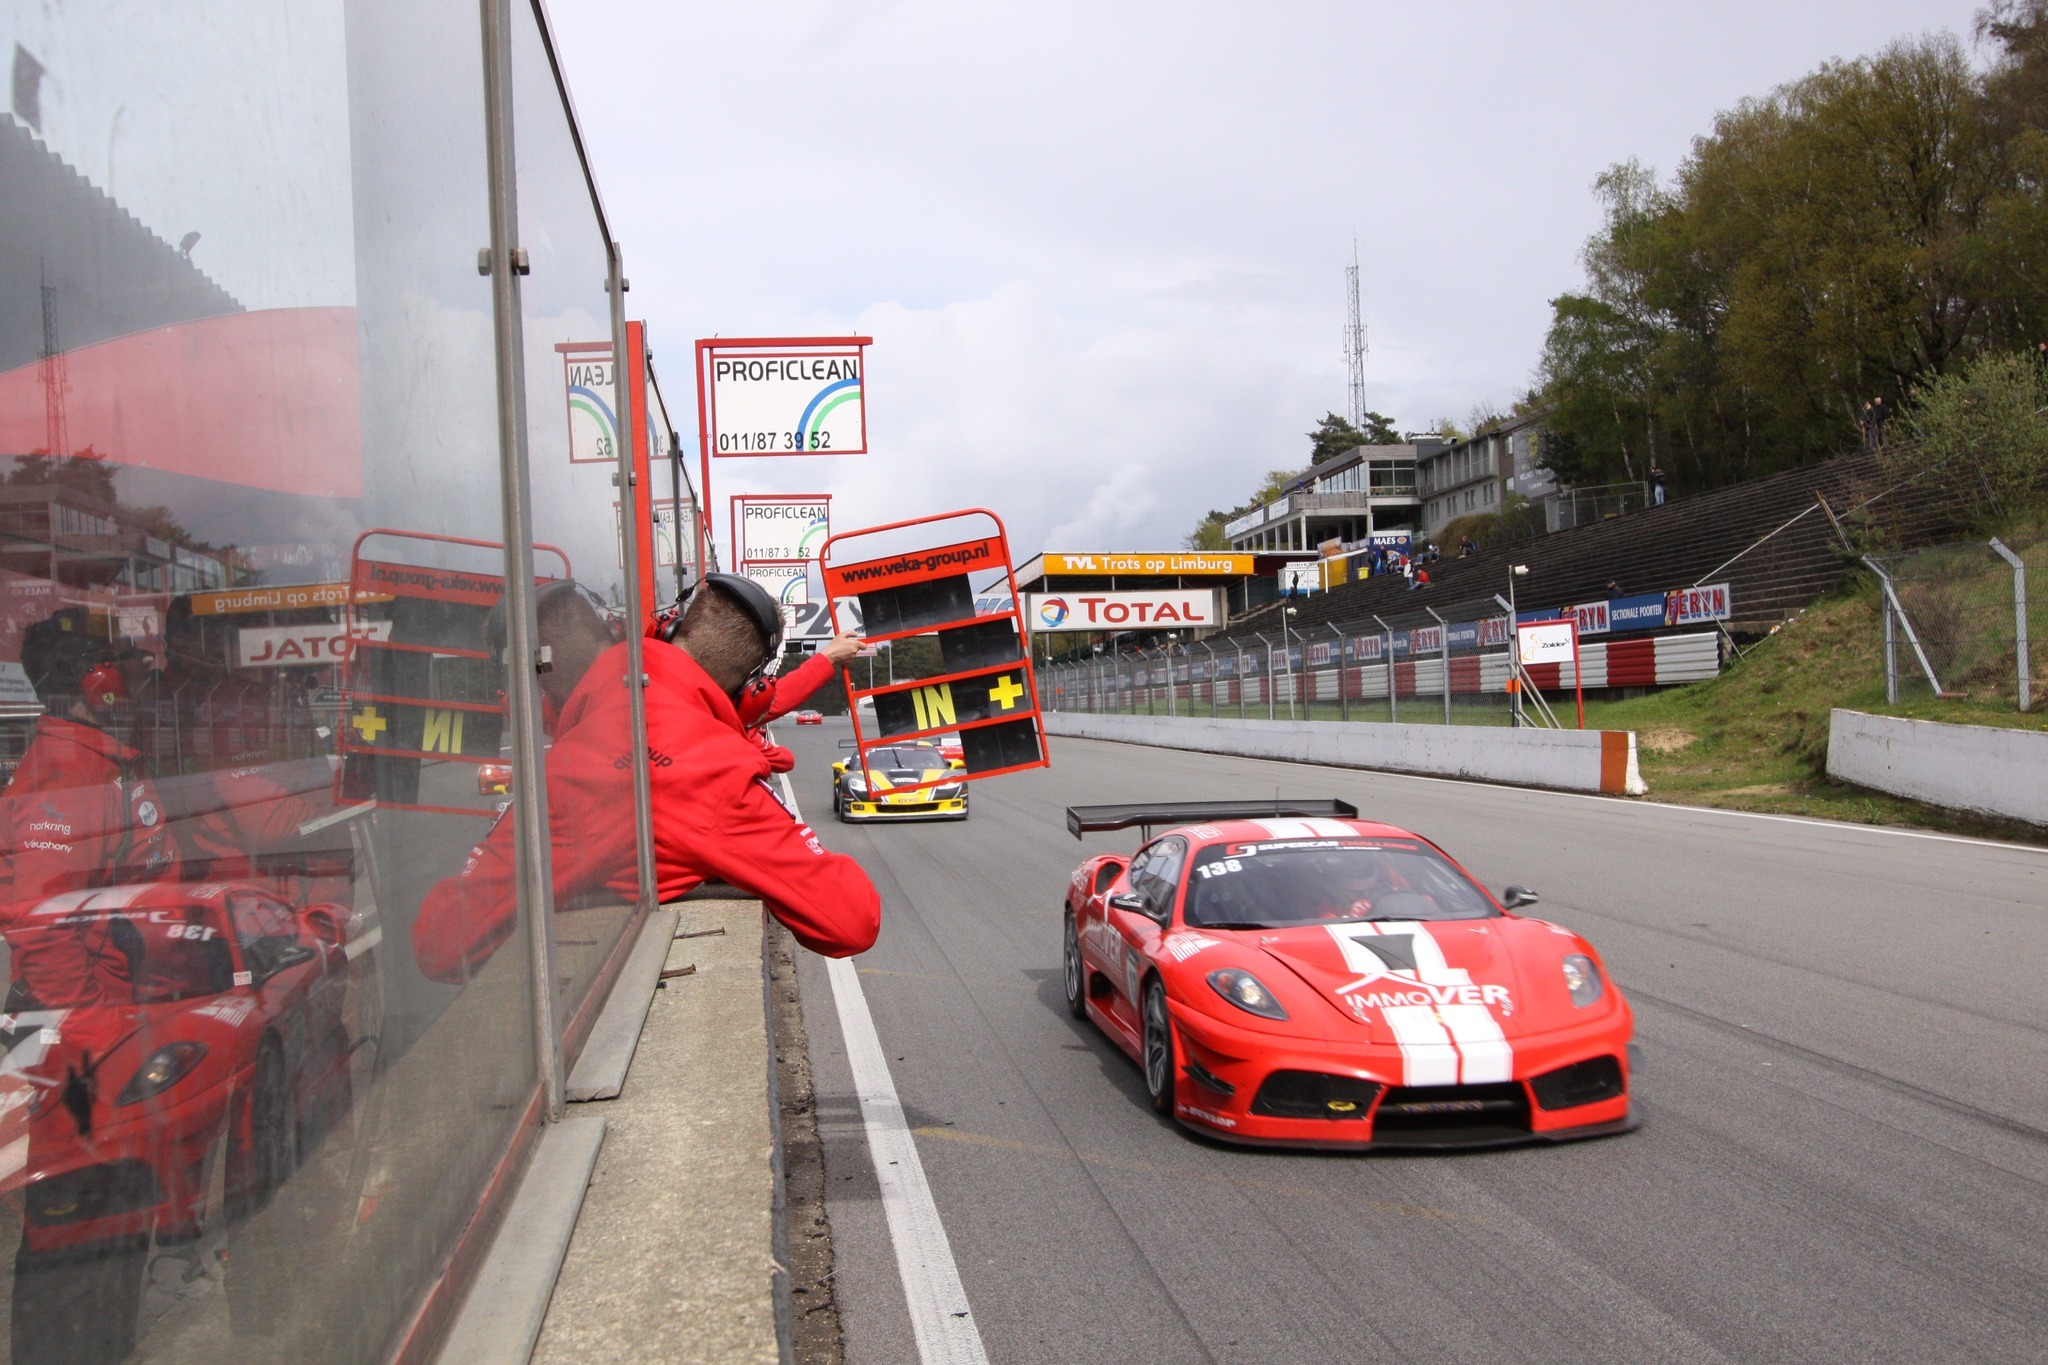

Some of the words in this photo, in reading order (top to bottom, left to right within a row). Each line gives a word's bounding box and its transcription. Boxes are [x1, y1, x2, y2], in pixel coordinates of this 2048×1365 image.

[716, 359, 858, 382] PROFICLEAN
[720, 432, 776, 451] 011/87
[784, 431, 804, 450] 39
[810, 431, 831, 449] 52
[746, 506, 826, 519] PROFICLEAN
[1373, 536, 1396, 546] MAES
[747, 547, 780, 559] 011/87
[798, 546, 811, 558] 52
[842, 541, 990, 584] www.veka-group.nl
[1063, 556, 1097, 570] TVL
[1101, 557, 1141, 570] Trots
[1146, 560, 1165, 573] op
[1171, 557, 1233, 573] Limburg
[749, 568, 806, 578] PROFICLEAN
[1078, 597, 1205, 623] TOTAL
[1612, 607, 1639, 621] SECTIONALE
[1639, 604, 1662, 618] POORTEN
[1667, 588, 1726, 619] FERYN
[1541, 641, 1566, 649] Zolder
[911, 682, 957, 730] IN
[29, 820, 71, 835] norkring
[1196, 859, 1243, 879] 138
[1344, 985, 1511, 1009] IMMOVER
